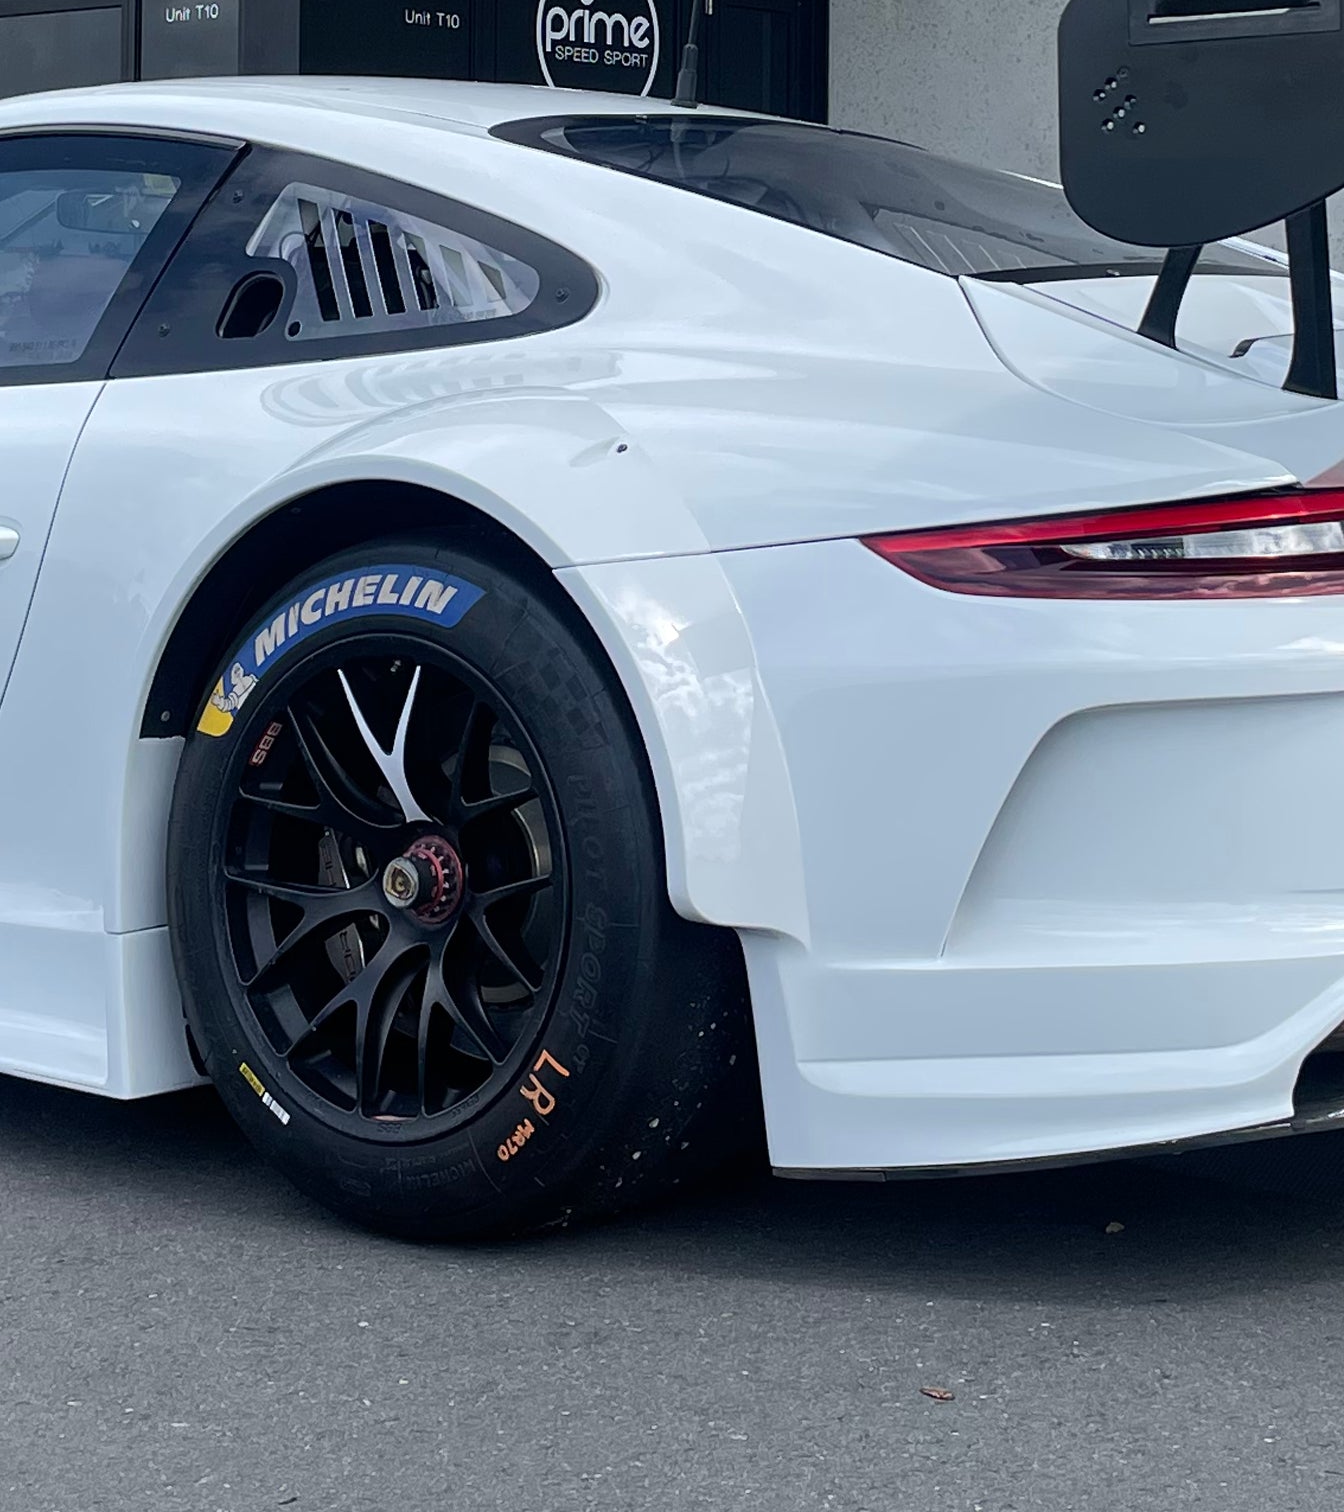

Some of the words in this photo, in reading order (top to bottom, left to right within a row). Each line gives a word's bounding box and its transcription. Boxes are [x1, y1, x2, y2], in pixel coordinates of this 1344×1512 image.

[165, 7, 191, 23] Unit
[195, 3, 219, 20] T10
[405, 9, 431, 25] Unit
[436, 12, 460, 29] T10
[555, 45, 599, 64] SPEED
[603, 50, 649, 67] SPORT
[255, 574, 458, 666] MICHELIN
[251, 721, 283, 766] BBS
[519, 1048, 570, 1116] LR
